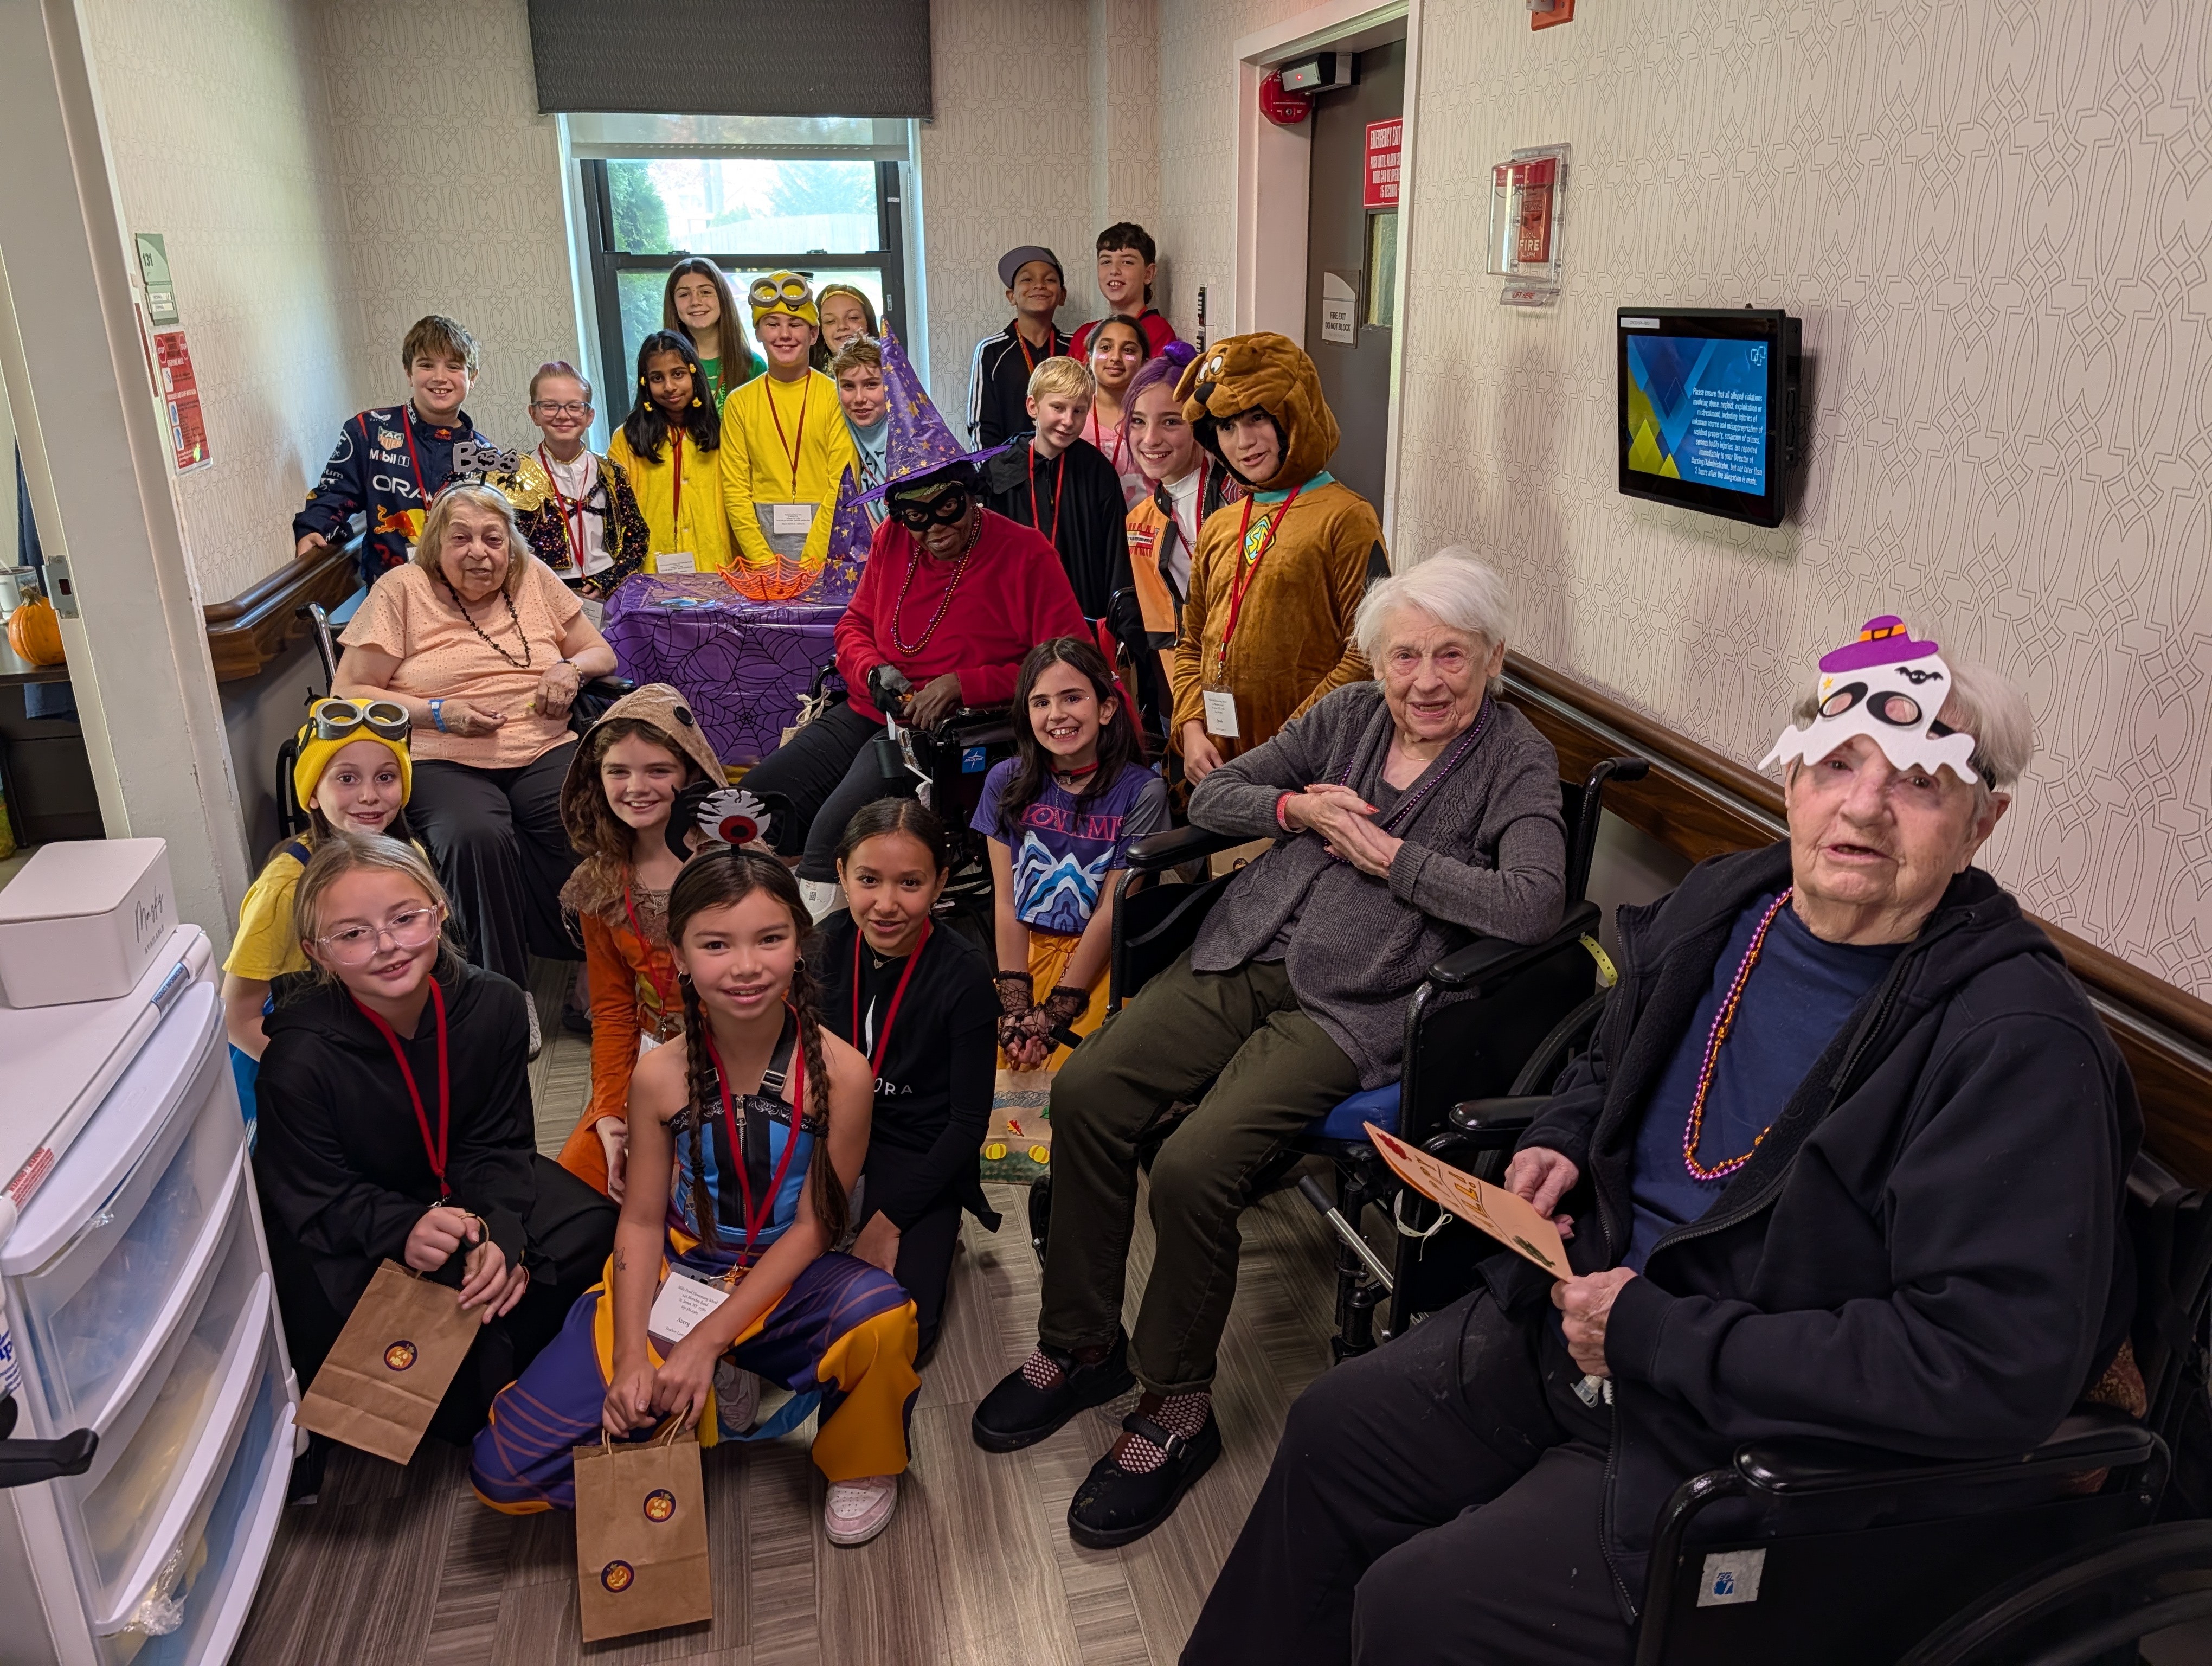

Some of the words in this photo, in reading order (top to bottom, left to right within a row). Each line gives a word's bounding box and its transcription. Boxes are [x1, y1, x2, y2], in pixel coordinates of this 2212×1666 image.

[1370, 127, 1392, 150] EMERGENCY
[1392, 125, 1401, 146] EXIT
[1378, 154, 1386, 168] UNTIL
[1386, 153, 1397, 167] ALARM
[1384, 184, 1398, 197] SECONDS
[1519, 239, 1540, 251] FIRE
[143, 252, 153, 267] 131
[1338, 312, 1346, 321] EXIT
[1325, 321, 1330, 329] DO
[1338, 323, 1351, 332] BLOCK
[1693, 387, 1704, 395] Please
[1730, 392, 1744, 401] alleged
[1744, 393, 1763, 402] violations
[1693, 398, 1708, 408] involving
[1735, 402, 1757, 412] exploitation
[407, 401, 417, 425] parco
[1721, 411, 1738, 421] including
[1738, 413, 1752, 422] injuries
[1727, 422, 1758, 433] misappropriation
[382, 430, 402, 439] TAG
[1725, 433, 1741, 441] suspicion
[1741, 446, 1758, 454] reported
[1733, 453, 1749, 463] Director
[1698, 467, 1708, 476] hours
[1708, 469, 1717, 477] after
[1724, 472, 1741, 482] allegation
[1744, 465, 1753, 474] later
[1753, 467, 1763, 476] than
[135, 885, 163, 943] Masks
[145, 924, 164, 954] AVAILABLE
[153, 984, 168, 1003] PRODUCT
[166, 966, 184, 990] INFORMATION
[693, 1291, 709, 1302] Elementary
[677, 1317, 690, 1328] Avery
